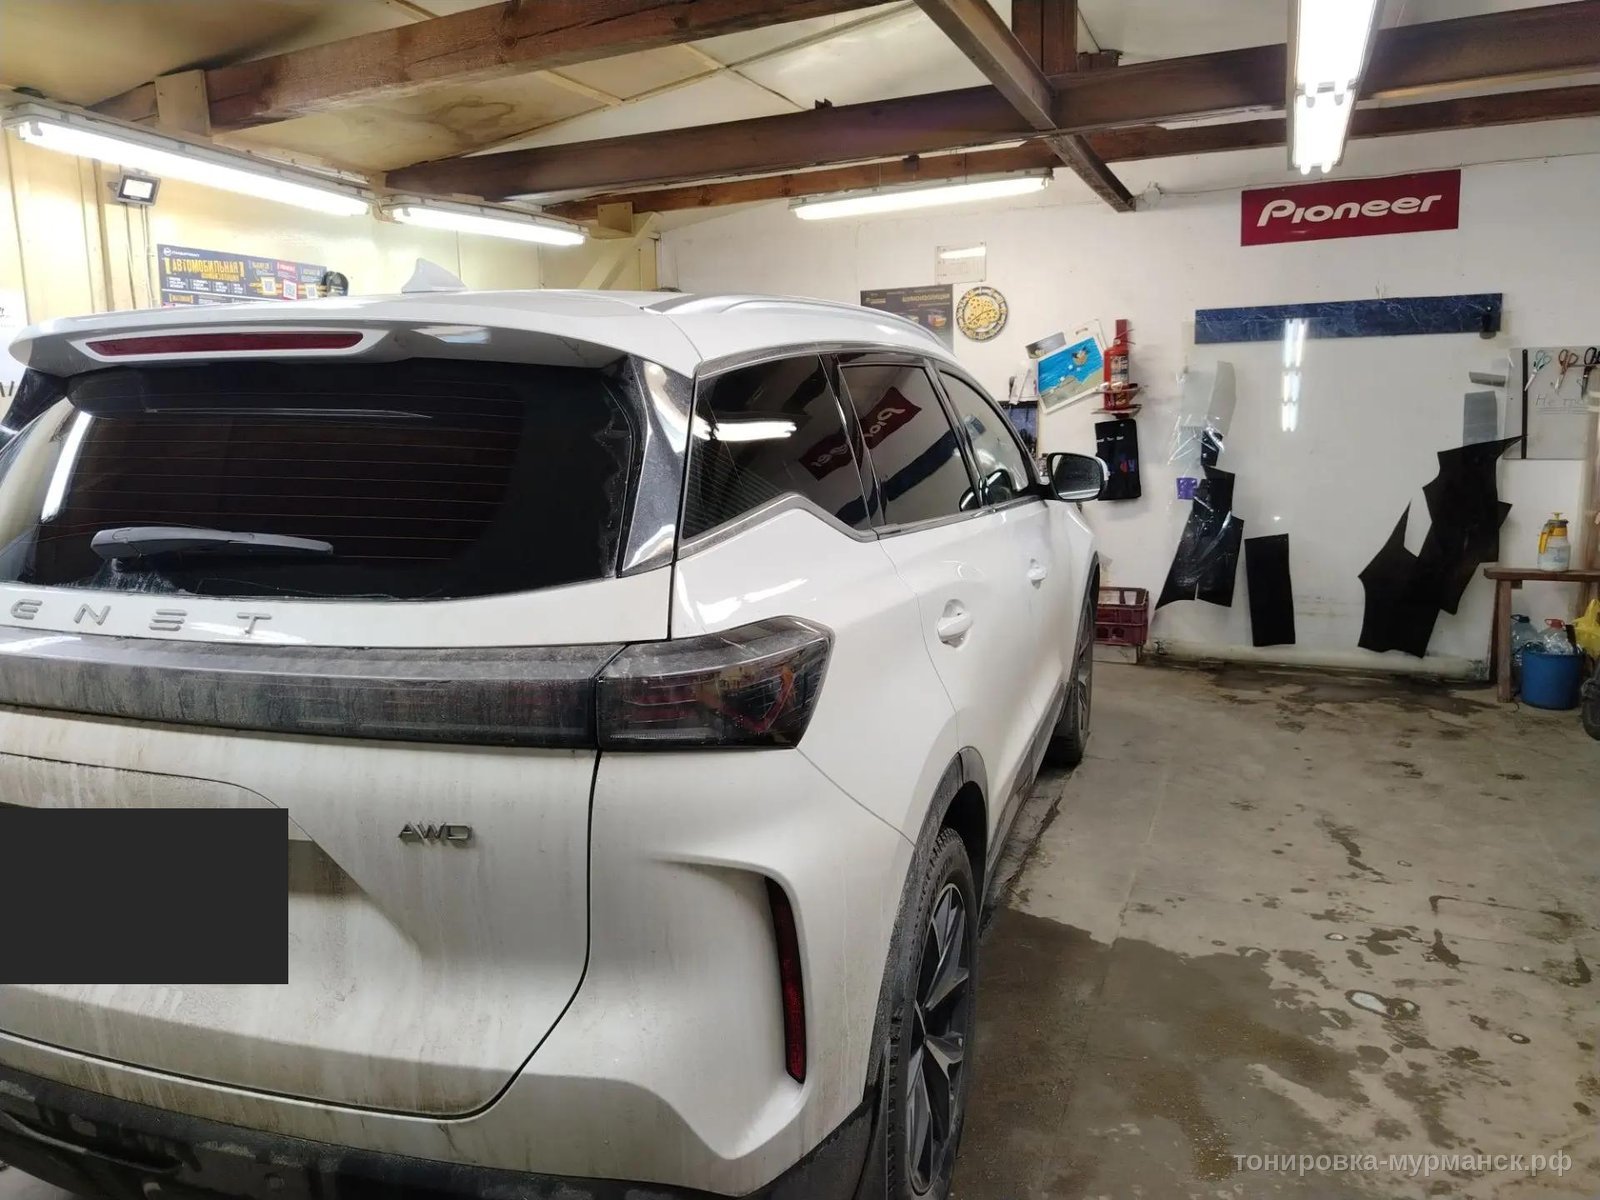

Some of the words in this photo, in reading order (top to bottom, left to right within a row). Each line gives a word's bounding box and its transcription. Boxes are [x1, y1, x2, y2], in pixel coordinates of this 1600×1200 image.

[1257, 194, 1442, 227] Pioneer
[172, 258, 240, 274] АВТОМОБИЛЬНАЯ
[398, 822, 473, 846] AWD
